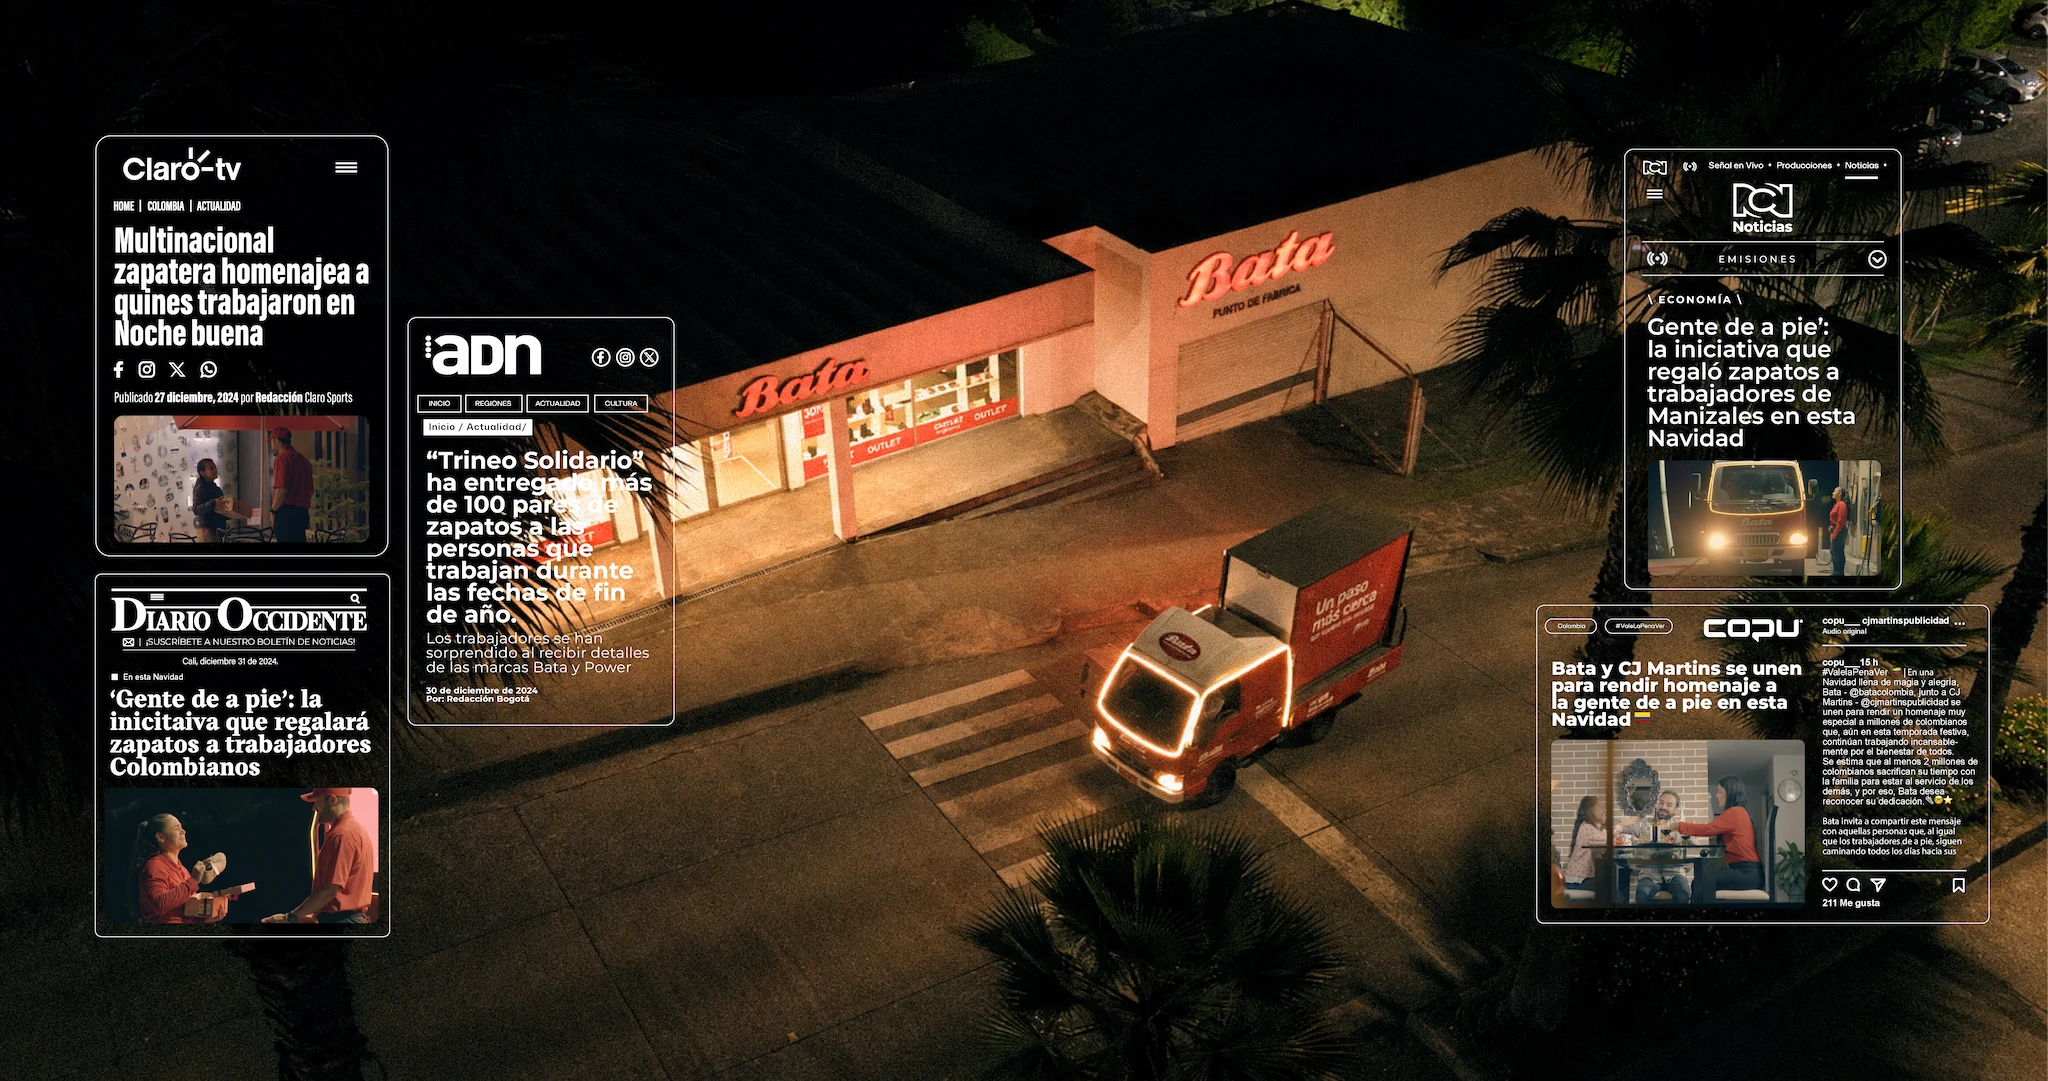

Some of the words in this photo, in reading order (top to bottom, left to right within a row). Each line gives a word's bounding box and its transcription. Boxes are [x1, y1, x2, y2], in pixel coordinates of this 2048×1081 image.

[1178, 230, 1336, 307] Bata
[1213, 302, 1245, 319] PUNTO
[1247, 296, 1260, 308] DE
[1262, 283, 1301, 304] FABRICA
[735, 357, 871, 418] Bata
[974, 404, 1007, 420] OUTLET
[867, 437, 902, 454] OUTLET
[1312, 608, 1340, 633] más
[1342, 590, 1377, 616] cerca
[1315, 597, 1335, 615] Un
[1336, 580, 1369, 608] paso
